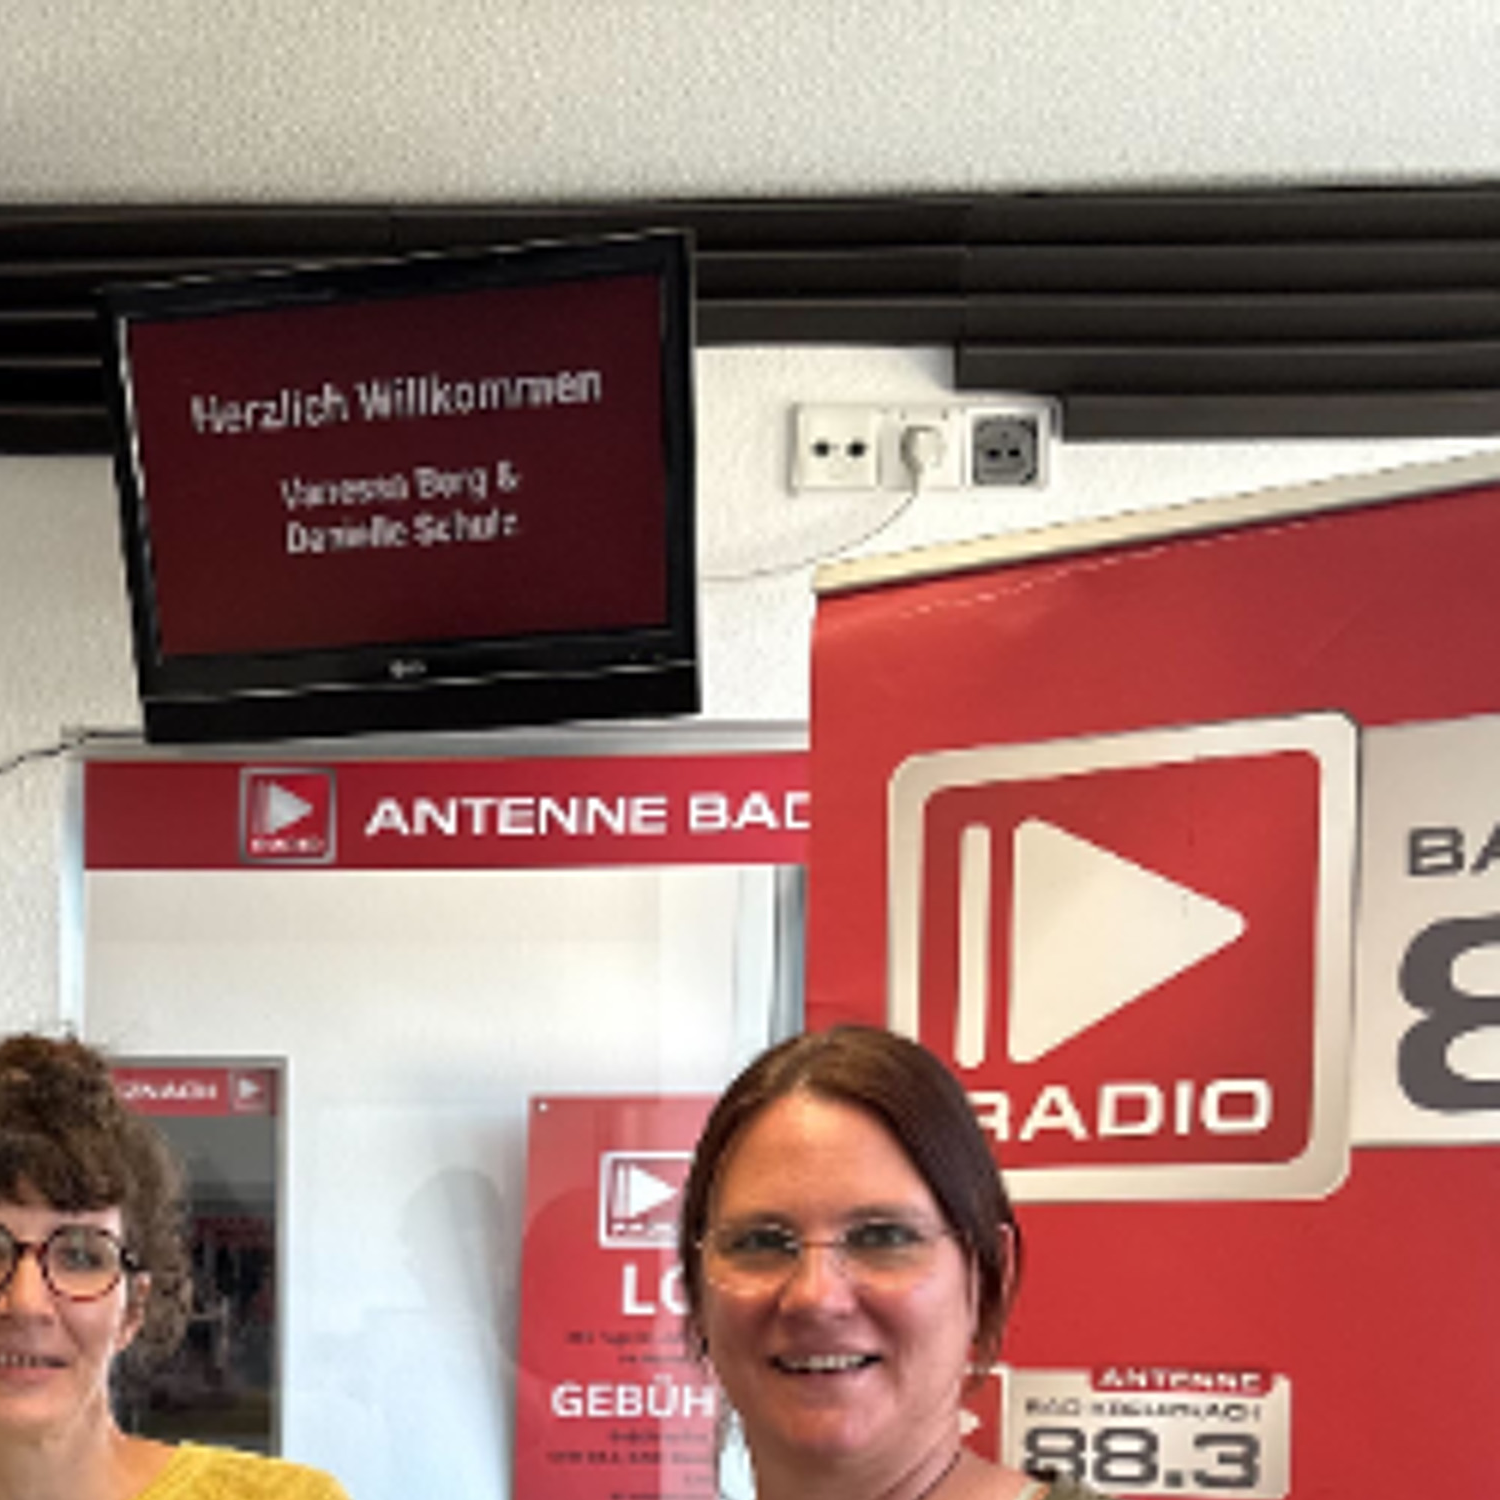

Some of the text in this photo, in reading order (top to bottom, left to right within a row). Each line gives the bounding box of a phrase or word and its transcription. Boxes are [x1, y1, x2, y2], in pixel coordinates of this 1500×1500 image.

[192, 371, 600, 432] Herzlich Willkommen
[498, 461, 521, 492] &
[365, 796, 667, 836] ANTENNE
[966, 1078, 1273, 1143] RADIO
[1099, 1368, 1261, 1389] ANTENNE
[1025, 1427, 1260, 1488] 88.3
